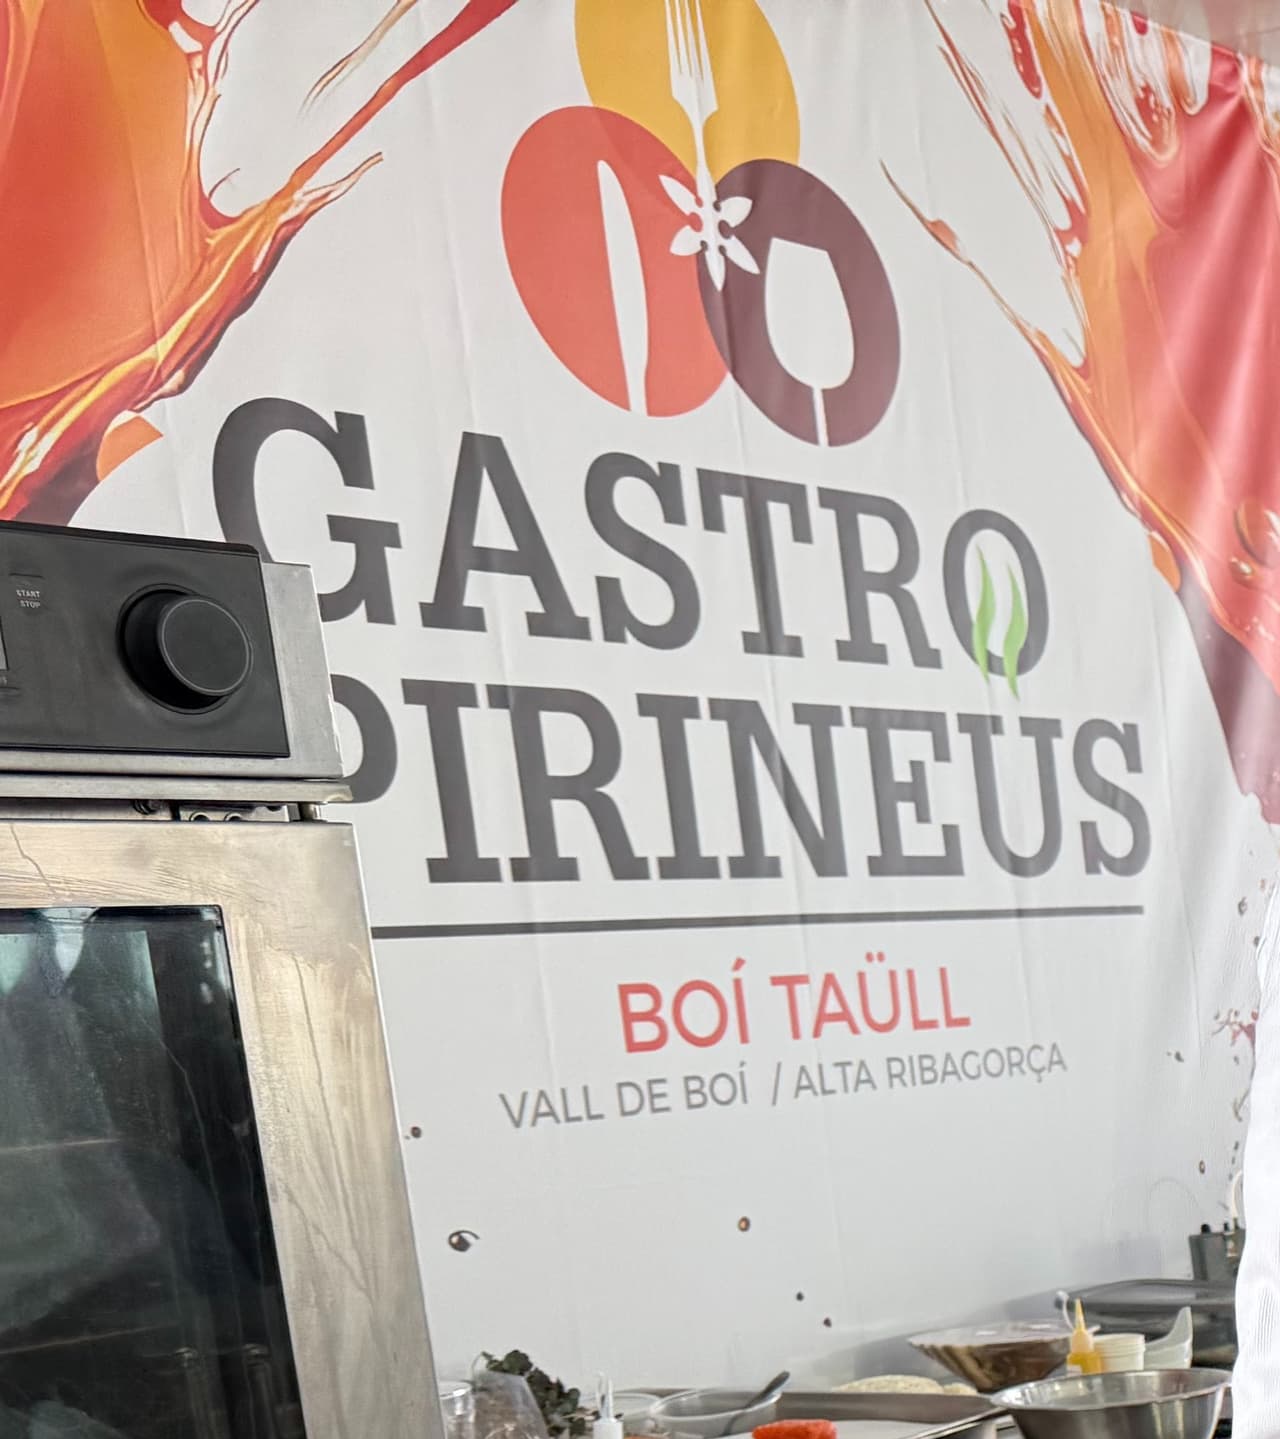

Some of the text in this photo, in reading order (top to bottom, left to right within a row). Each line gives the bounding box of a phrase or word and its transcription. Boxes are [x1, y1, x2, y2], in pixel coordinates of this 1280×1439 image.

[212, 397, 1049, 677] GASTRO
[617, 951, 971, 1053] BOÍ TAÜLL
[499, 1084, 605, 1129] VALL
[616, 1077, 669, 1117] DE
[683, 1061, 749, 1110] BOÍ
[793, 1058, 877, 1100] ALTA
[884, 1041, 1068, 1091] RIBAGORÇA
